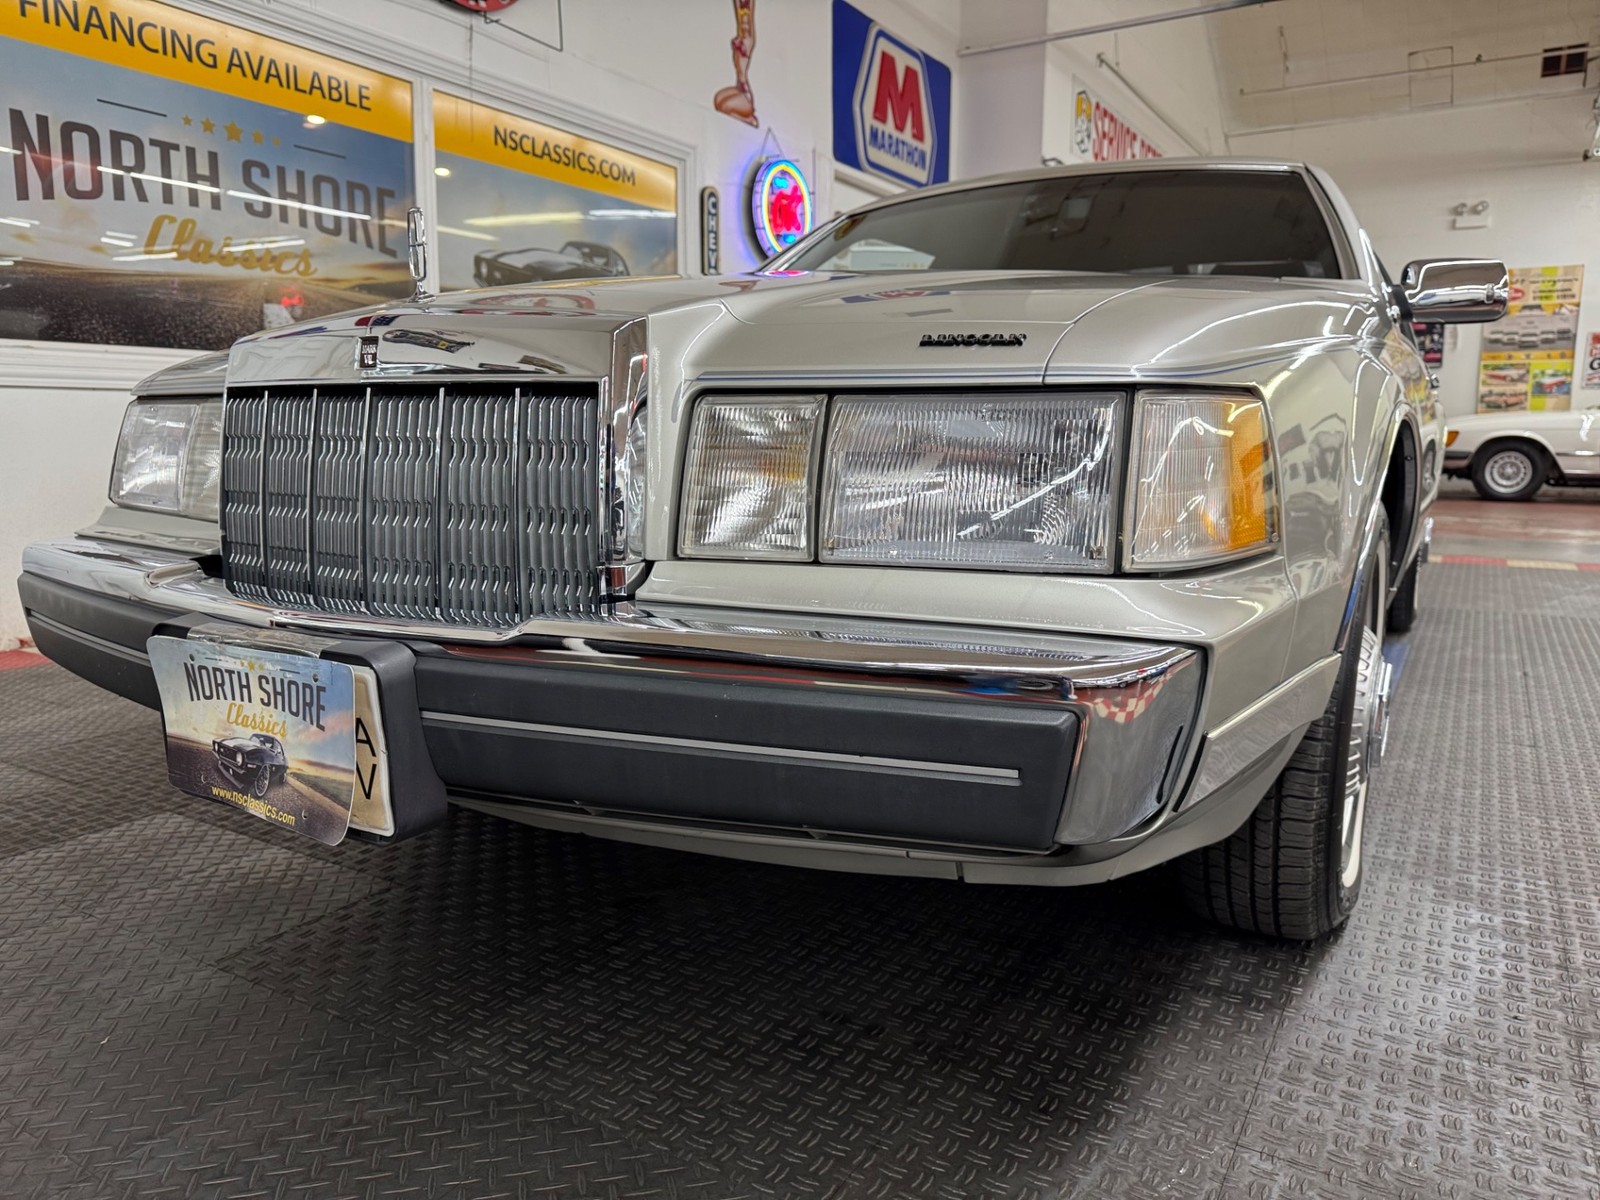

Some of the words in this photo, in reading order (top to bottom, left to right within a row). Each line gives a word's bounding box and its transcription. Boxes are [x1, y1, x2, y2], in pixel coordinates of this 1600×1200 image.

[18, 0, 218, 69] FINANCING
[226, 47, 372, 111] AVAILABLE
[873, 50, 925, 143] M
[493, 125, 637, 187] NSCLASSICS.COM
[868, 124, 927, 171] MARATHON
[9, 107, 222, 211] NORTH
[242, 157, 398, 259] SHORE
[143, 213, 318, 277] Classics
[183, 660, 253, 703] NORTH
[258, 673, 326, 732] SHORE
[226, 701, 288, 738] Classics
[211, 785, 296, 826] www.nsclassics.com
